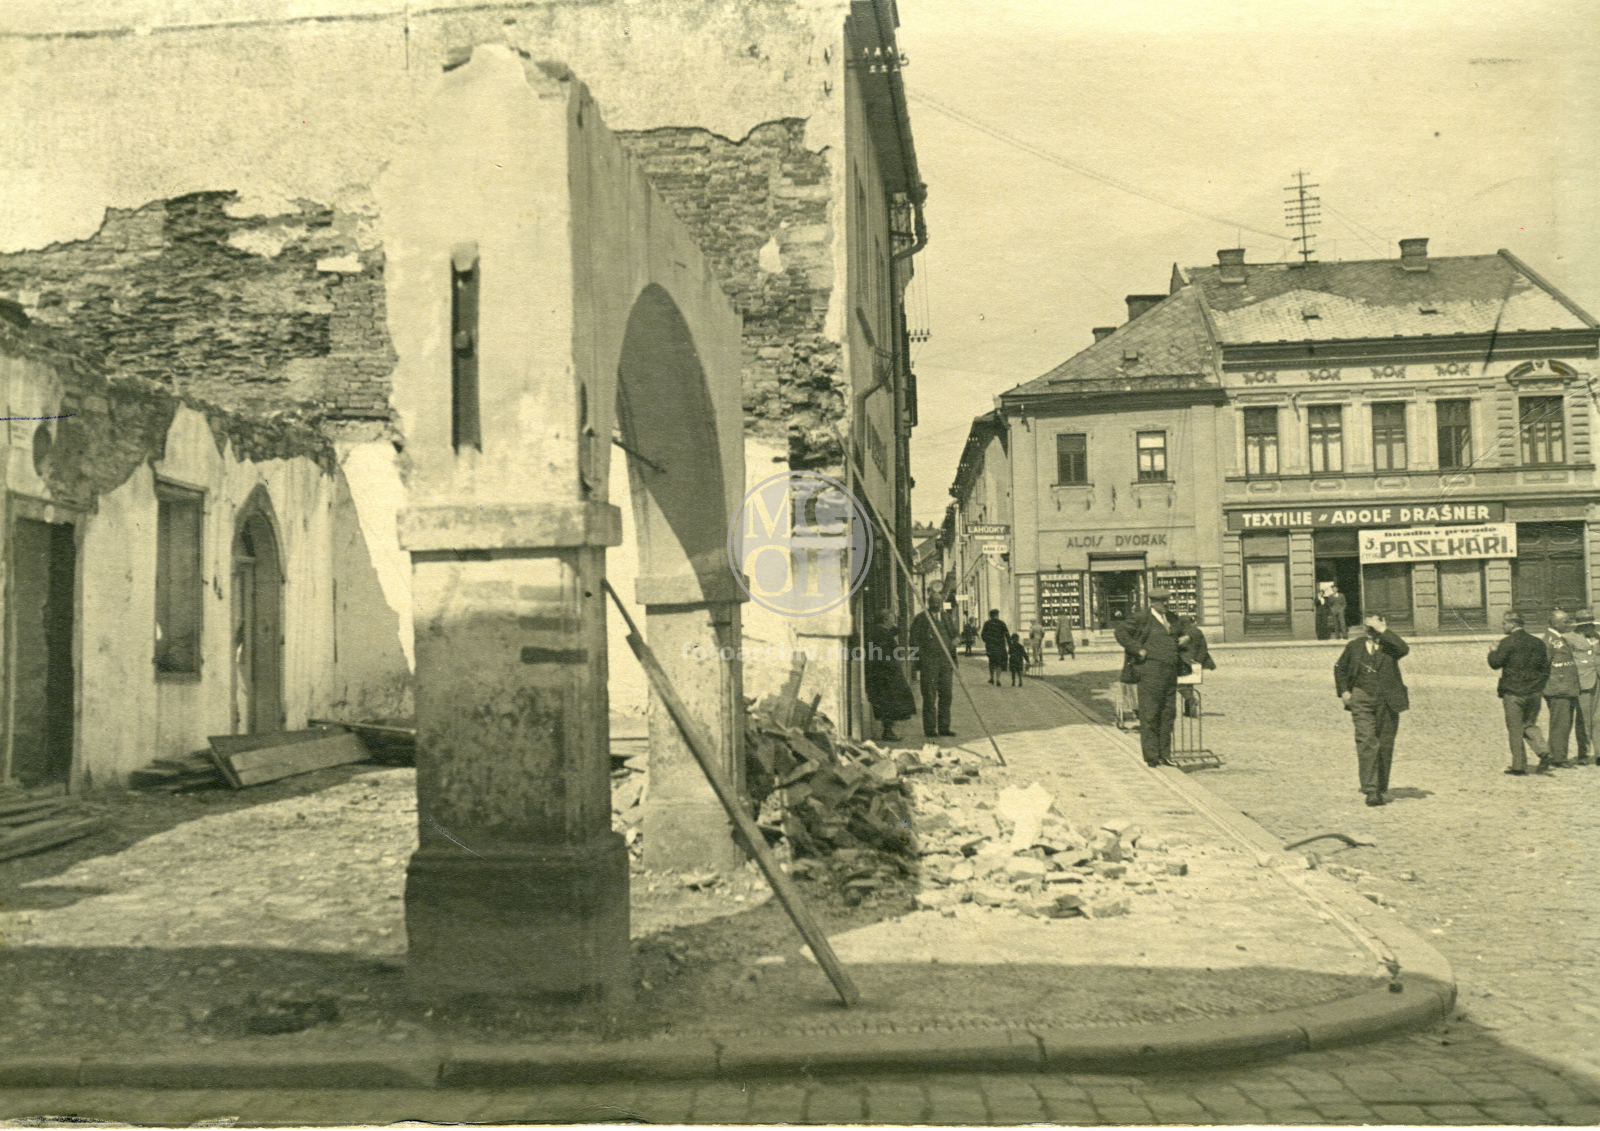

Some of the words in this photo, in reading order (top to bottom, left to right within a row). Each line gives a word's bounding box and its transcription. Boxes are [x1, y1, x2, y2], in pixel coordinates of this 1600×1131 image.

[1242, 511, 1313, 527] TEXTILIE
[1331, 508, 1392, 525] ADOLF
[1399, 504, 1491, 522] DRAŠNER
[1066, 536, 1104, 548] ALOIS
